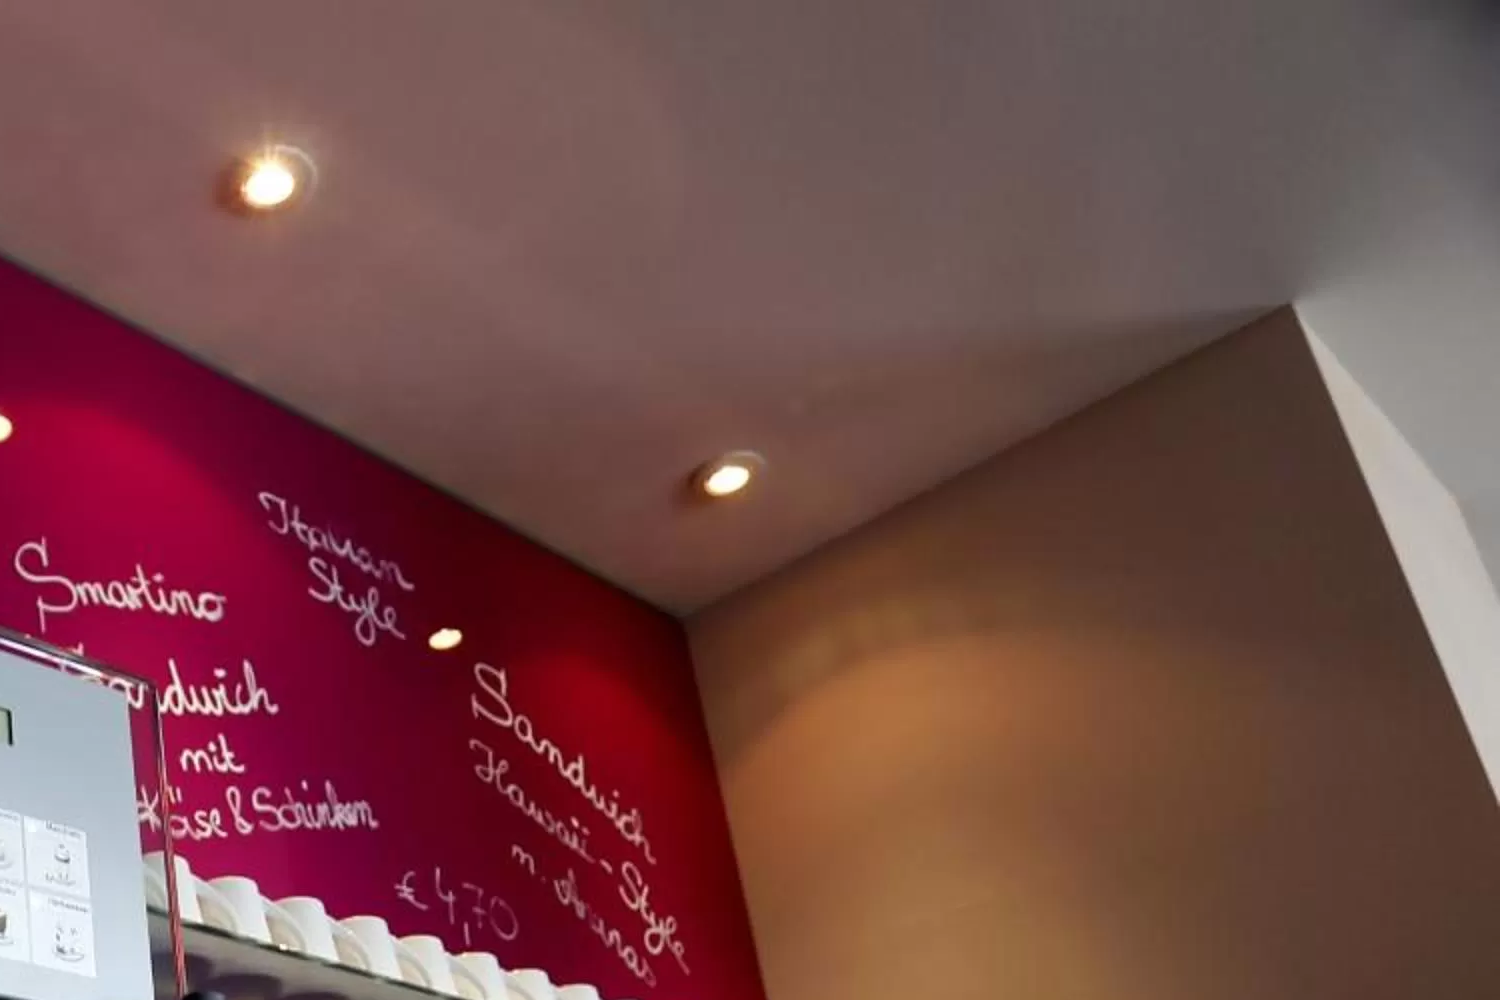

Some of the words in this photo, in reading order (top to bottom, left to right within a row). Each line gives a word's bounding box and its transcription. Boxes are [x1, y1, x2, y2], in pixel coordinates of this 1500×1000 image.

[15, 537, 226, 633] Smartino
[307, 556, 406, 647] Style
[180, 733, 245, 773] mit
[471, 662, 657, 865] Sandwich
